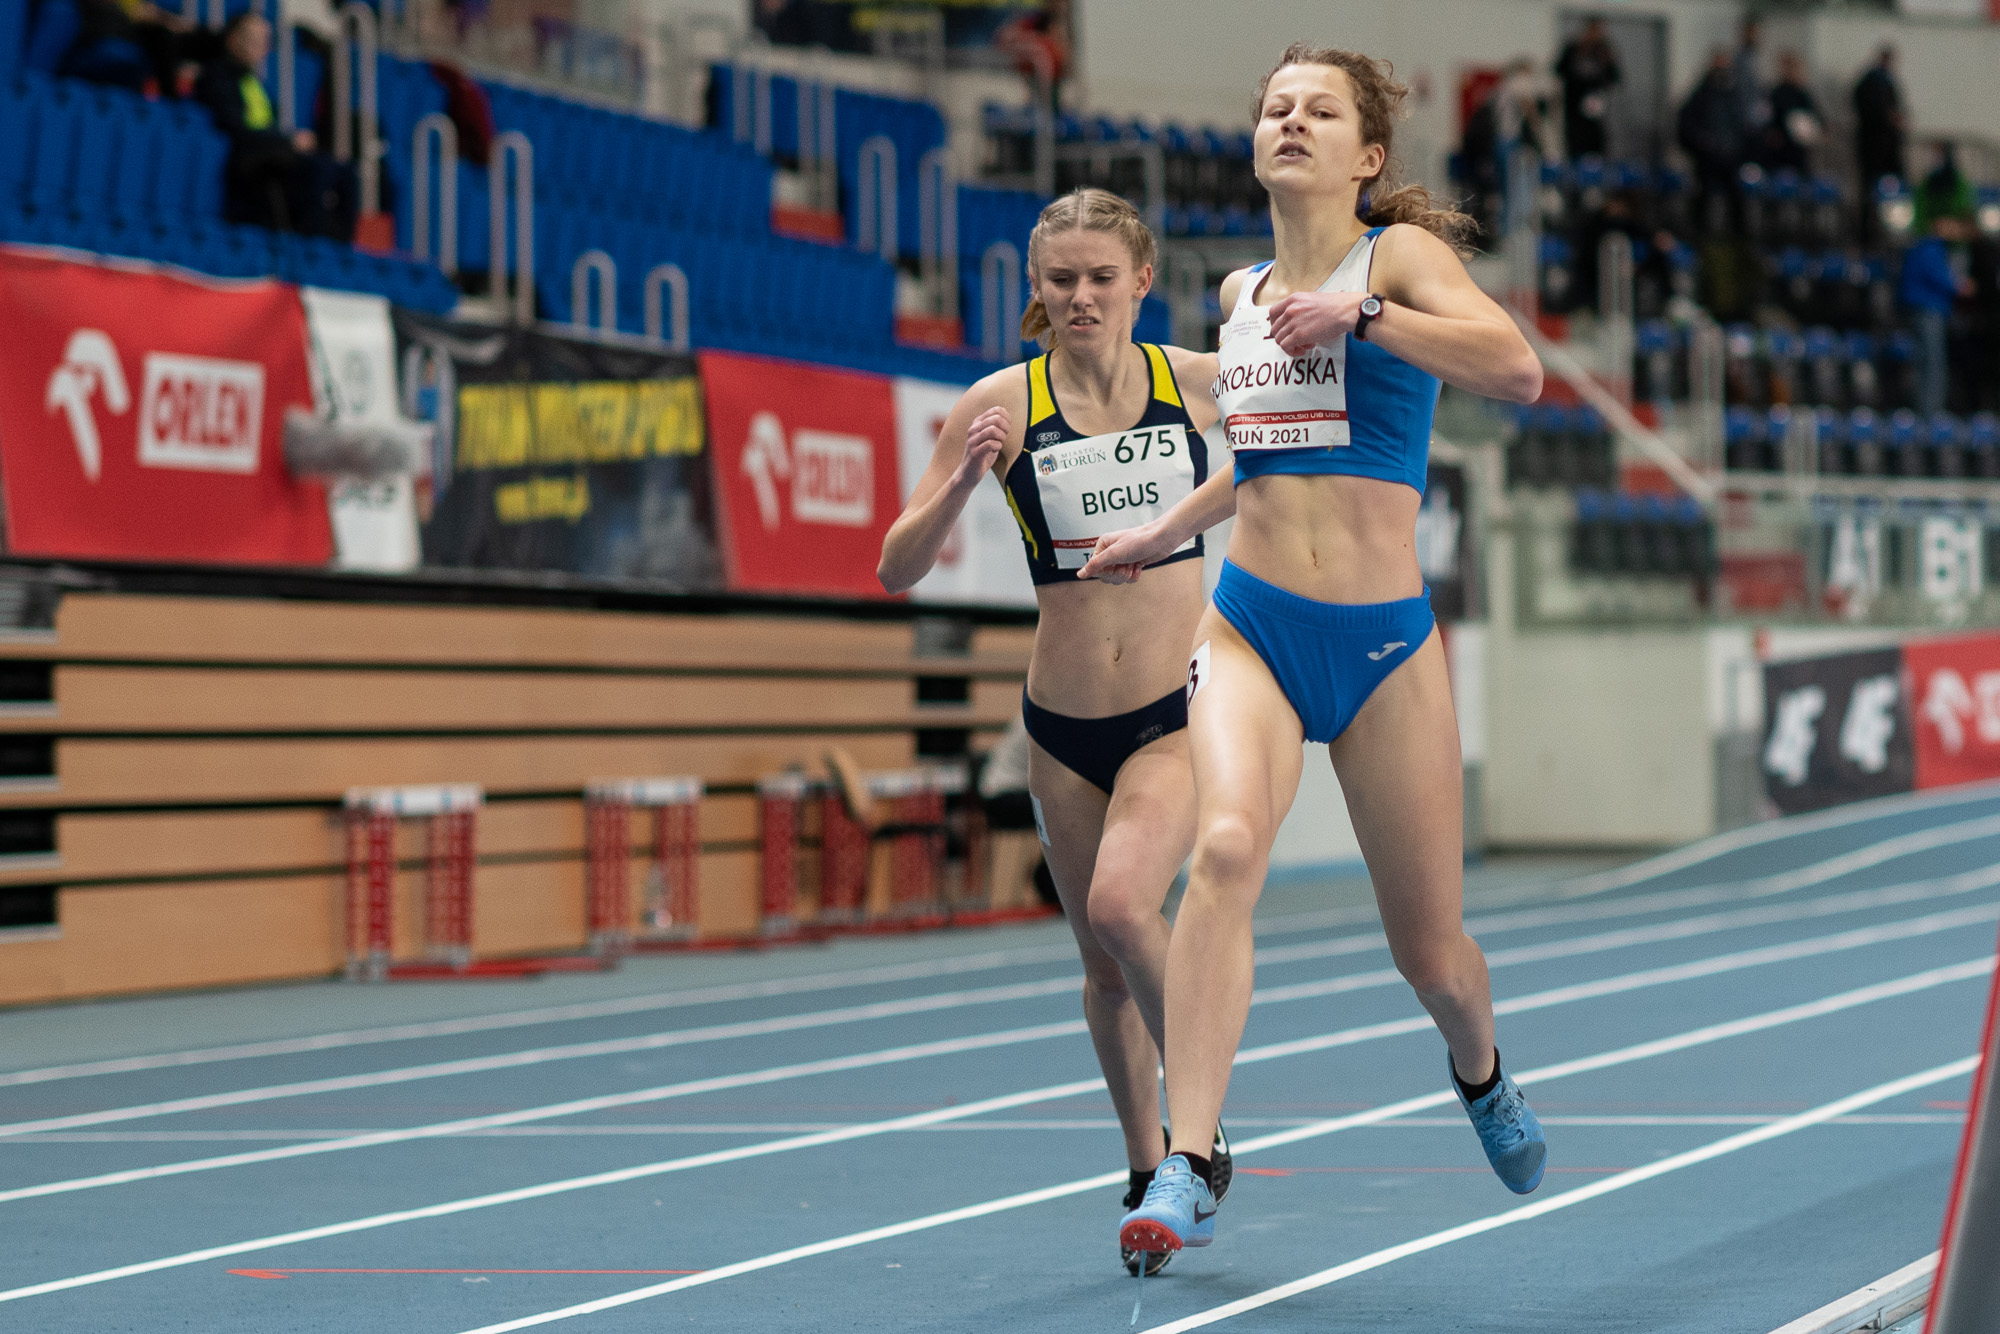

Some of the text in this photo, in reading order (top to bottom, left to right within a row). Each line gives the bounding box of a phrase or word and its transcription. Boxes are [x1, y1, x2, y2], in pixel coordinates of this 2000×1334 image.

[1212, 357, 1338, 399] OKOŁOWSKA
[1114, 430, 1176, 464] 675
[1270, 428, 1309, 444] 2021
[1061, 447, 1095, 459] MIASTO
[1061, 449, 1107, 469] TORUŃ
[1082, 482, 1159, 516] BIGUS
